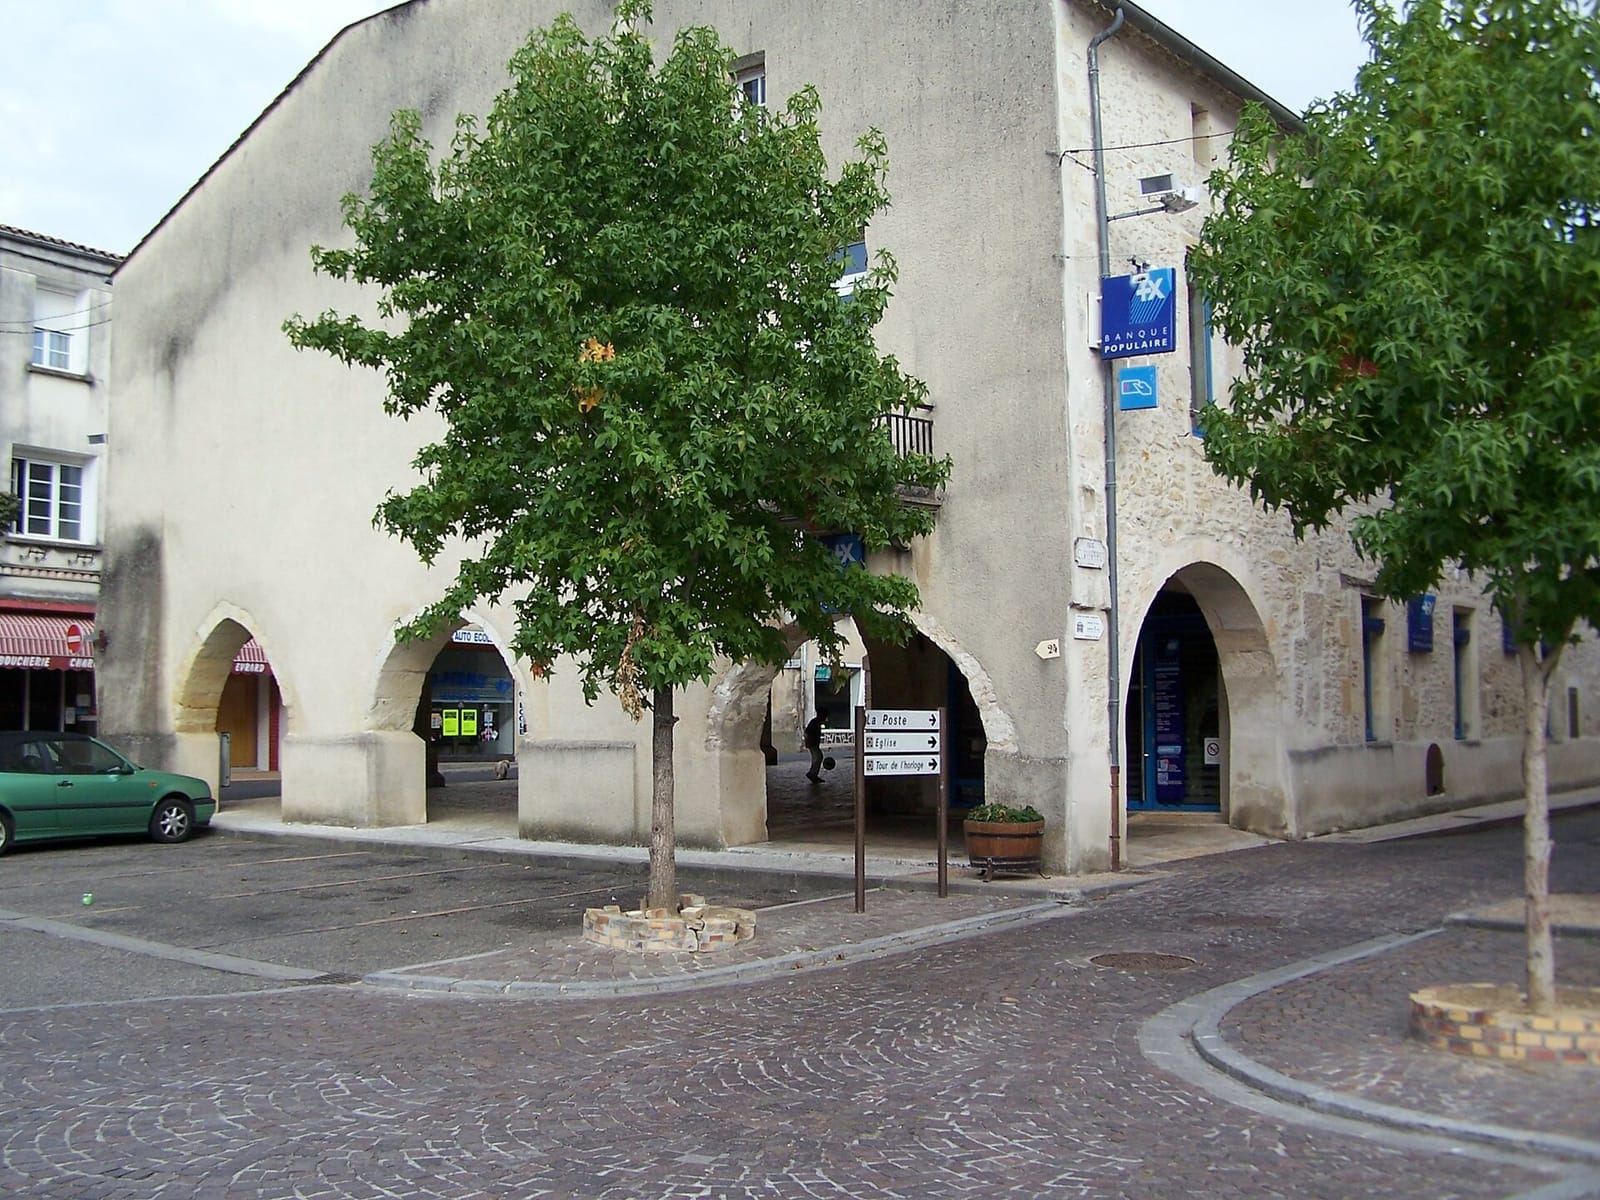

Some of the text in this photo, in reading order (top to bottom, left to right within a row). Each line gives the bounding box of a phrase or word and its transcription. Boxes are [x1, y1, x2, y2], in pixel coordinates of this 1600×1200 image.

[1104, 326, 1168, 342] BANQUE
[1104, 338, 1168, 353] POPULAIRE
[454, 631, 471, 641] AUTO
[0, 655, 50, 667] BOUCHERIE
[866, 713, 907, 726] La Poste
[875, 738, 897, 749] Eglise
[876, 761, 888, 770] Tour
[891, 760, 898, 770] de
